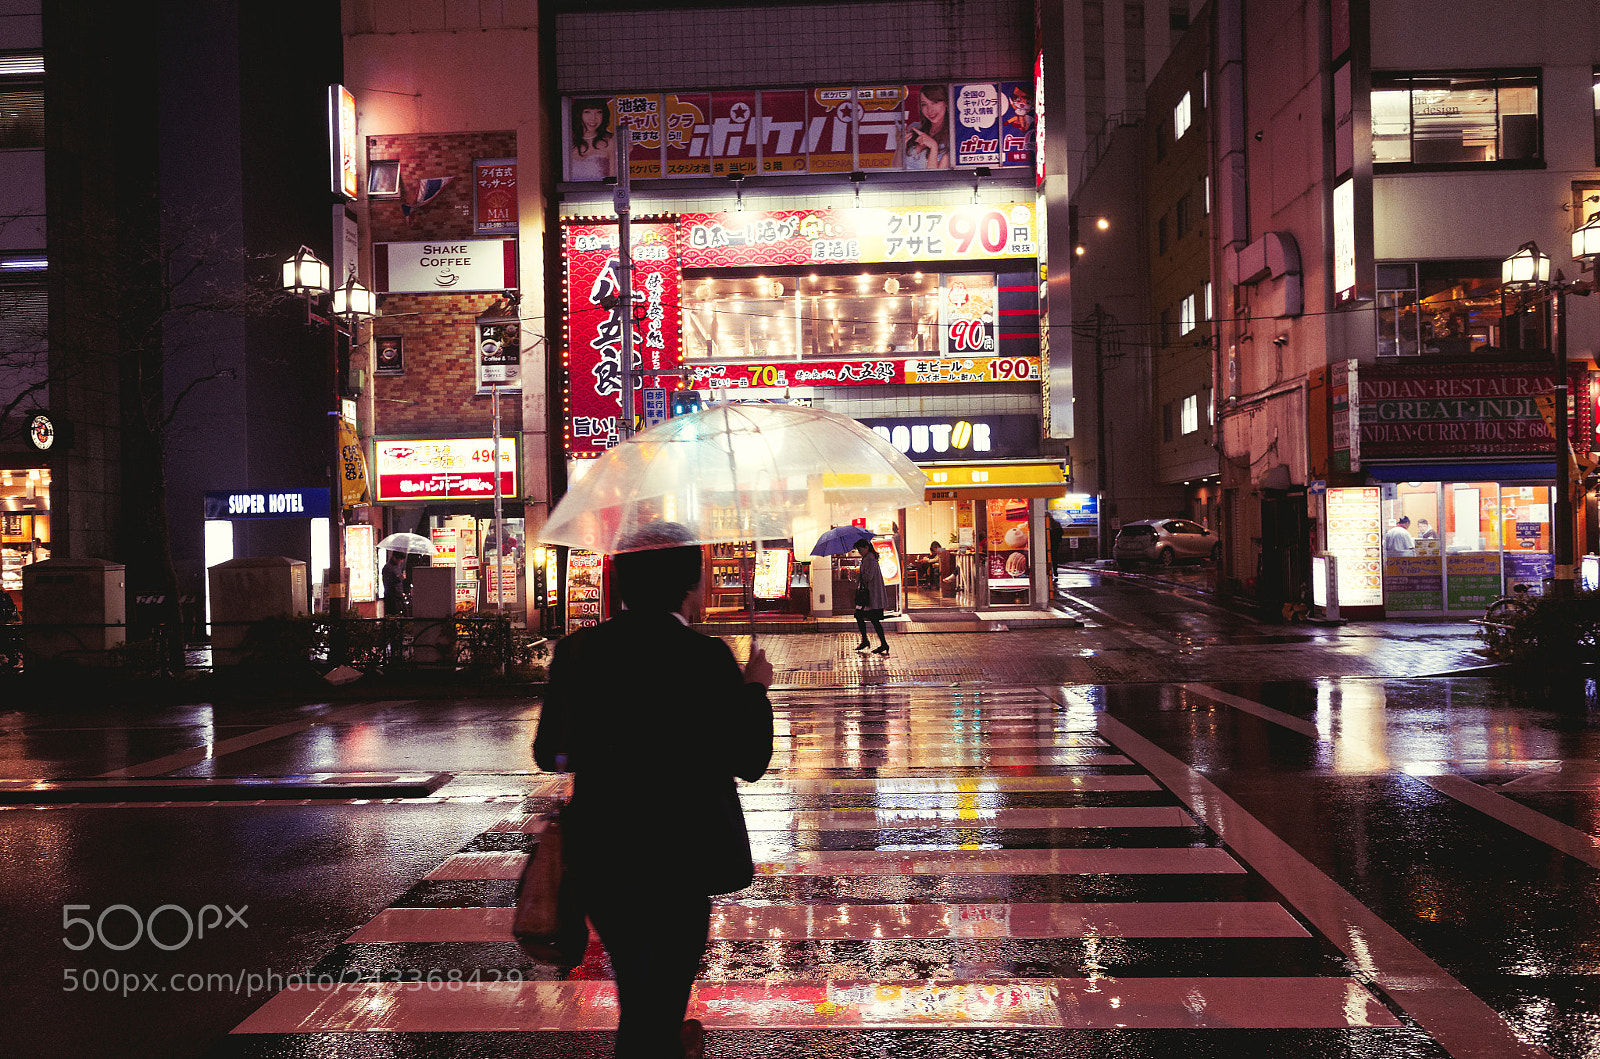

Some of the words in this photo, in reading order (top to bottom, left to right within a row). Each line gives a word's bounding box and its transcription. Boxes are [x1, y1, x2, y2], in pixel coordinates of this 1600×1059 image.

[618, 97, 656, 113] 池袋で
[963, 107, 993, 116] 求人情報
[1423, 104, 1459, 116] design
[811, 160, 852, 168] POKEPARA
[859, 158, 890, 167] STUDIO
[481, 167, 513, 178] タイ古式
[478, 178, 516, 189] マッサージ
[487, 208, 509, 219] MAI
[886, 215, 942, 233] クリア
[948, 211, 1008, 254] 90
[1013, 228, 1028, 242] 円
[423, 245, 468, 255] SHAKE
[814, 242, 858, 257] 居酒屋
[886, 236, 942, 255] アサヒ
[420, 257, 472, 267] COFFEE
[483, 326, 496, 336] 2F
[950, 319, 984, 350] 90
[837, 362, 895, 383] 八五郎
[917, 361, 962, 373] 生ビール
[989, 359, 1030, 379] 190
[748, 365, 777, 386] 70
[646, 391, 655, 418] 自転車
[655, 391, 663, 418] 歩行者
[574, 416, 615, 436] 旨い!
[1476, 420, 1526, 440] HOUSE
[593, 435, 619, 449] 一品
[872, 420, 991, 453] DOUTOR
[228, 493, 266, 514] SUPER
[269, 493, 304, 513] HOTEL
[584, 588, 598, 599] 70
[582, 603, 597, 614] 90
